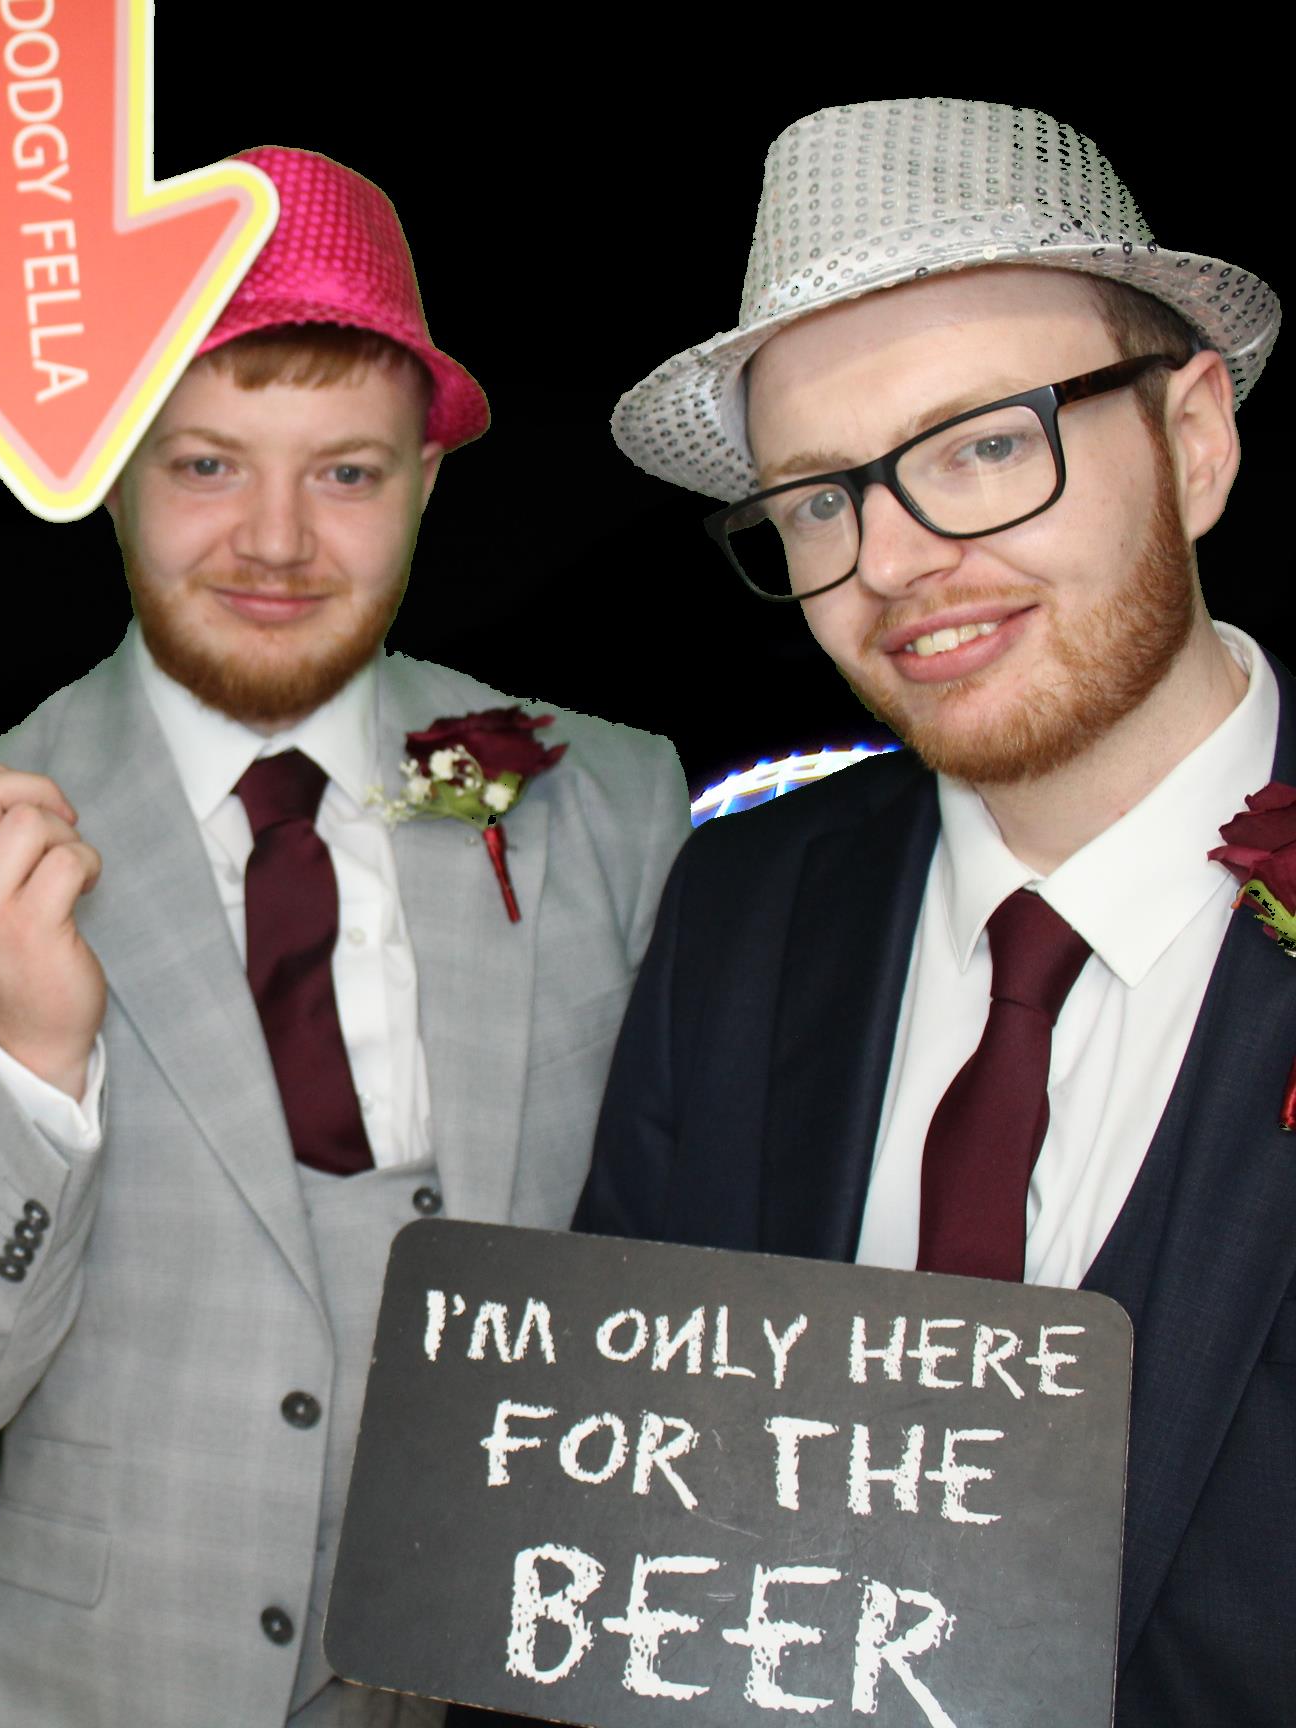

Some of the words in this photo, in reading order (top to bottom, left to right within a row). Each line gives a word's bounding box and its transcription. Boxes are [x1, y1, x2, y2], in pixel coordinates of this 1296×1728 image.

[20, 219, 89, 404] FELLA
[424, 1289, 557, 1364] I'M
[595, 1305, 810, 1390] ONLY
[847, 1315, 1087, 1400] HERE
[479, 1399, 702, 1511] FOR
[763, 1415, 1007, 1526] THE
[504, 1542, 959, 1728] BEER
